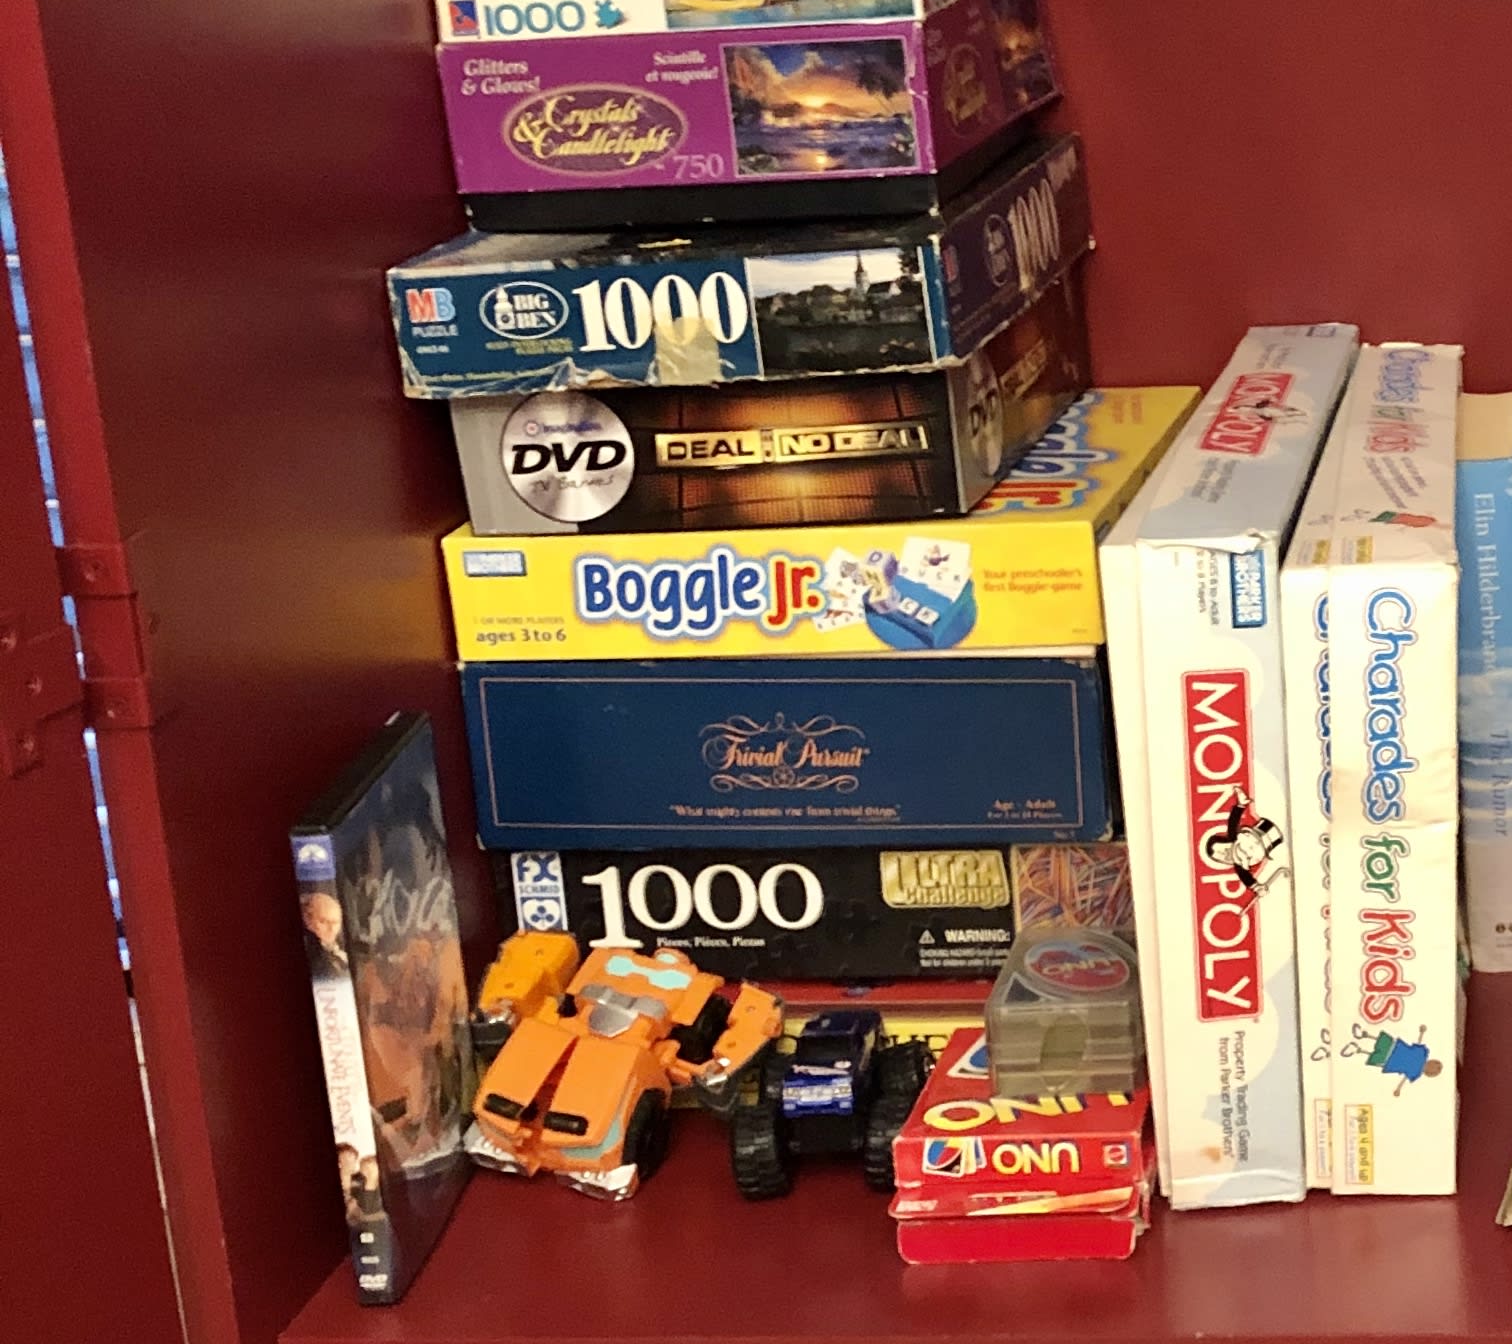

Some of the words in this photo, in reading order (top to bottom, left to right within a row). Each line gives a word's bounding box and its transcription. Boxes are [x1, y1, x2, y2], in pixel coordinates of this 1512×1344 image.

[484, 0, 586, 36] 1000
[463, 58, 529, 76] Glitters
[461, 78, 476, 95] &
[480, 76, 540, 95] Glows!
[544, 95, 648, 138] Crystals
[513, 112, 545, 143] &
[531, 124, 675, 166] Candlelight
[671, 154, 725, 180] 750
[406, 288, 456, 323] MB
[513, 293, 549, 311] BIG
[573, 271, 749, 353] 1000
[411, 324, 459, 337] PUZZLE
[516, 311, 557, 329] BEN
[667, 439, 755, 460] DEAL
[780, 432, 832, 455] NO
[833, 425, 929, 452] DEAL
[511, 440, 627, 475] DVD
[1472, 492, 1495, 538] Elin
[983, 568, 1007, 579] Your
[1008, 582, 1051, 596] Boggle
[1053, 583, 1083, 595] game
[580, 550, 765, 634] Boggle
[766, 561, 822, 627] Jr.
[1249, 567, 1263, 622] PARKER
[476, 630, 516, 646] ages
[521, 629, 531, 642] 3
[534, 630, 551, 643] to
[556, 628, 567, 642] 6
[1366, 588, 1418, 823] Charades
[704, 734, 790, 770] Trivial
[793, 737, 866, 769] Pursuit
[1491, 774, 1511, 837] Rumor
[1190, 680, 1254, 1011] MONOPOLY
[517, 855, 558, 882] FX
[881, 851, 1002, 898] ULTRA
[1363, 834, 1409, 899] for
[519, 884, 561, 895] SCHMID
[581, 862, 823, 949] 1000
[904, 886, 1008, 907] Challenge
[1361, 910, 1415, 1021] Kids
[1218, 1037, 1229, 1065] from
[1233, 1031, 1247, 1082] Property
[1219, 1068, 1232, 1105] Parker
[1238, 1084, 1249, 1129] Trading
[1357, 1108, 1370, 1135] Ages
[1237, 1130, 1250, 1162] Game
[1358, 1136, 1370, 1145] 4
[1358, 1146, 1370, 1167] and
[992, 1142, 1081, 1174] UNO
[1357, 1168, 1369, 1182] up
